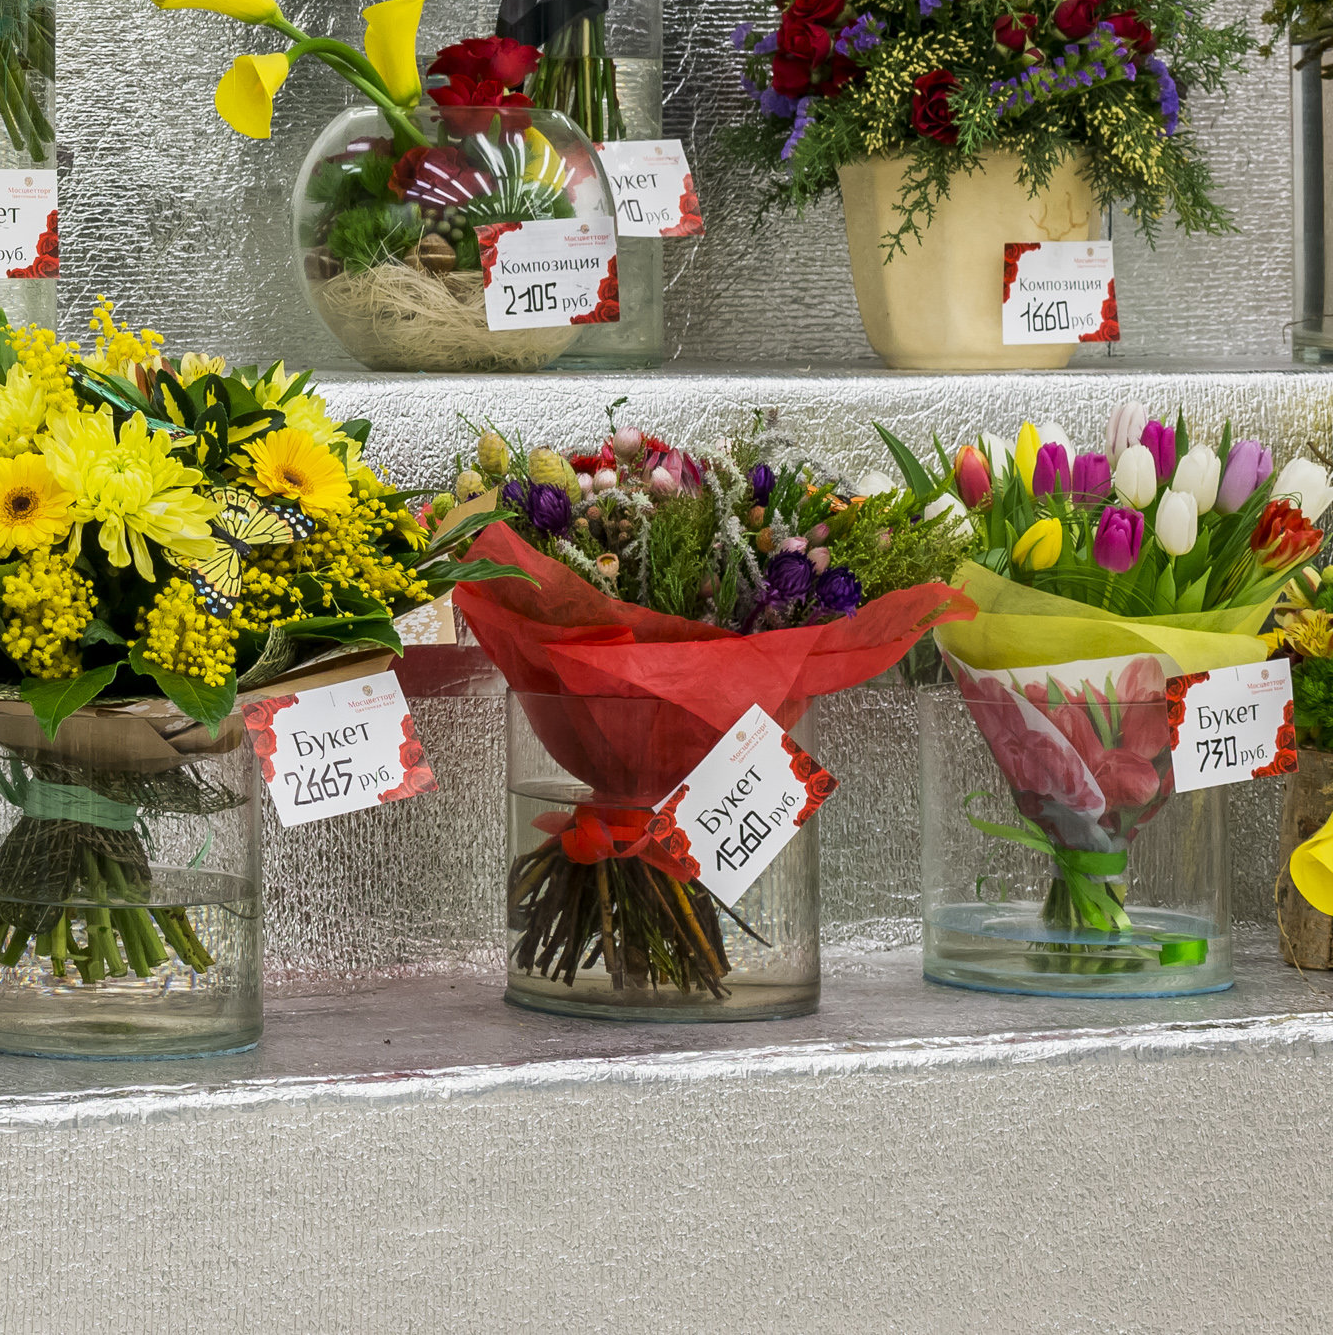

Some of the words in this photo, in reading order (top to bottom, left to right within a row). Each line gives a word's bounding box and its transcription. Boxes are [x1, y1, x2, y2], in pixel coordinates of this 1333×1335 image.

[609, 173, 658, 195] укет
[645, 208, 673, 225] руб.
[500, 257, 600, 274] Композиция
[1019, 277, 1102, 293] Композиция
[504, 282, 557, 315] 2105
[562, 293, 592, 312] руб.
[1071, 313, 1097, 330] руб.
[348, 693, 397, 708] Мосцветторг
[1197, 704, 1259, 734] Букет
[289, 722, 369, 760] Букет
[1196, 736, 1237, 772] 730
[1240, 744, 1268, 766] руб.
[358, 765, 394, 791] руб.
[695, 765, 762, 835] Букет
[715, 810, 771, 872] 1560
[768, 792, 800, 827] руб.
